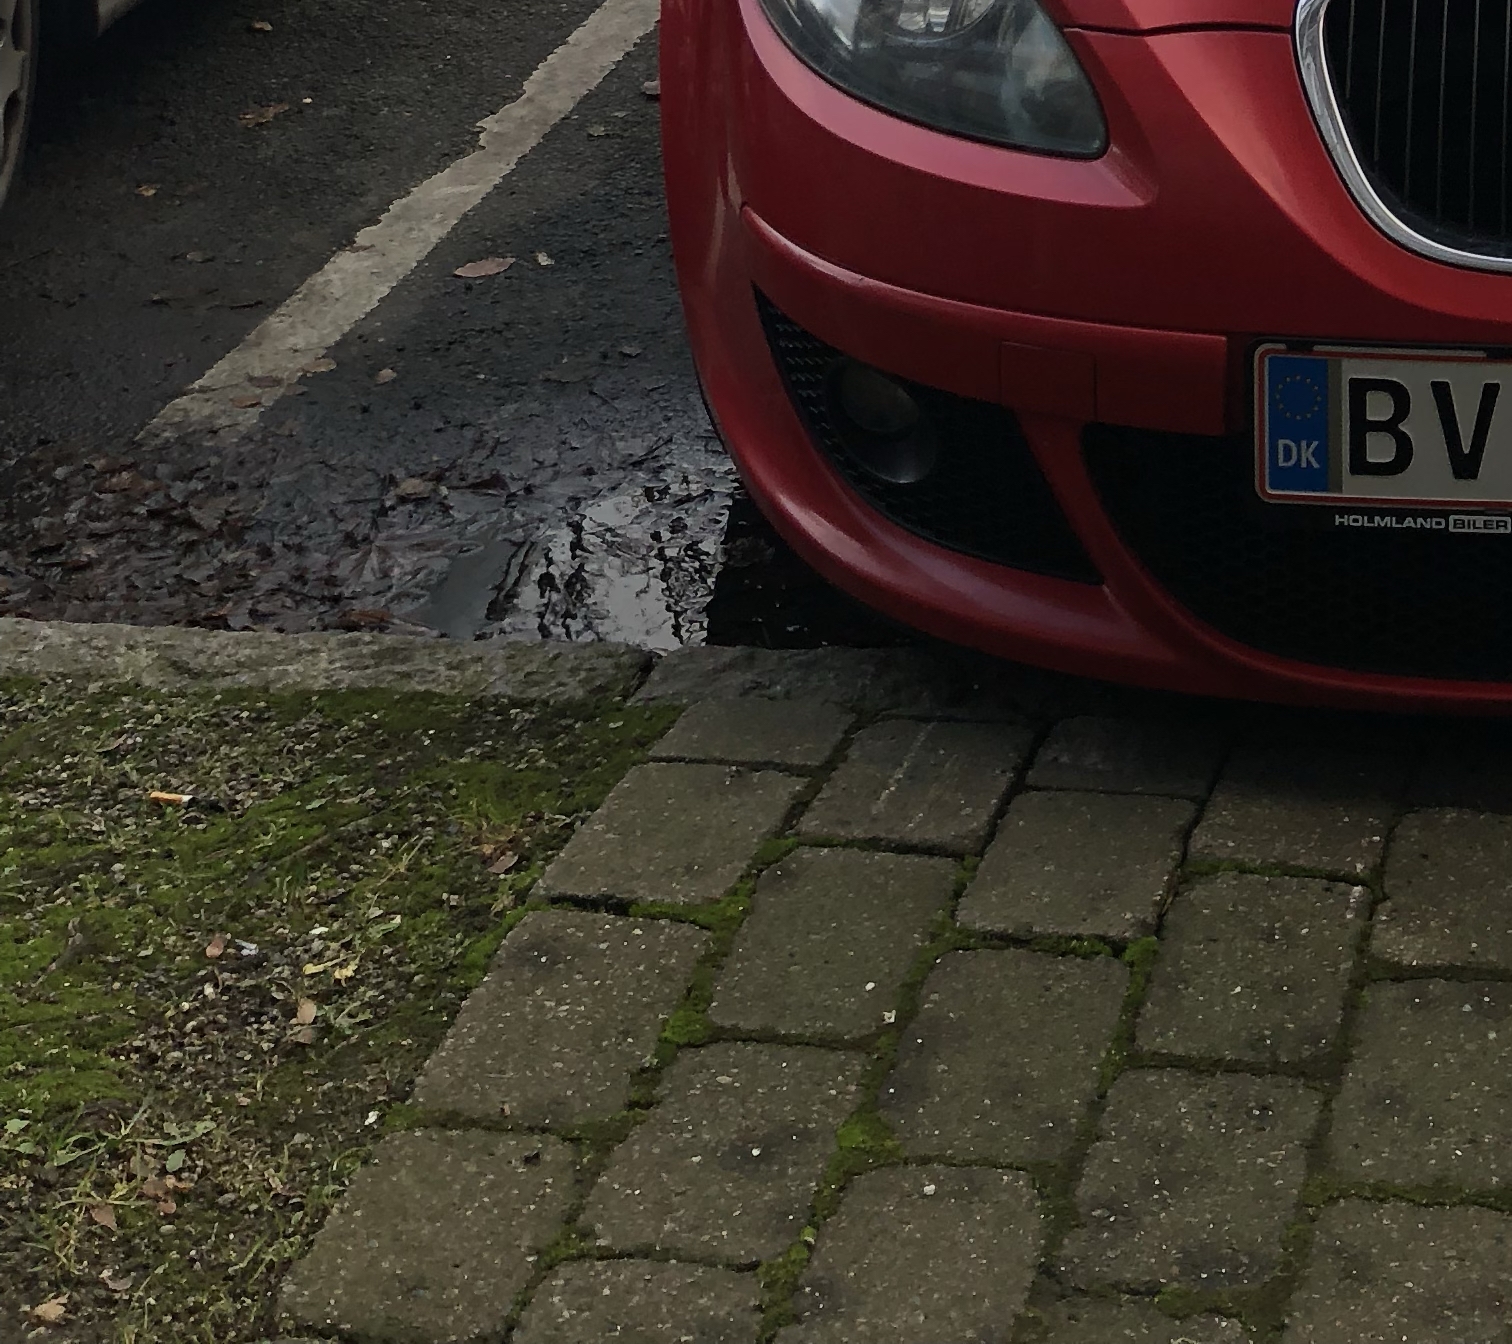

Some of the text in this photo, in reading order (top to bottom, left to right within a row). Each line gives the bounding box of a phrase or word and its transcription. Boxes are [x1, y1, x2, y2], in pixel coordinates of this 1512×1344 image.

[1348, 377, 1500, 480] BV
[1277, 439, 1321, 469] DK
[1335, 514, 1509, 531] HOLMLAND BILER
